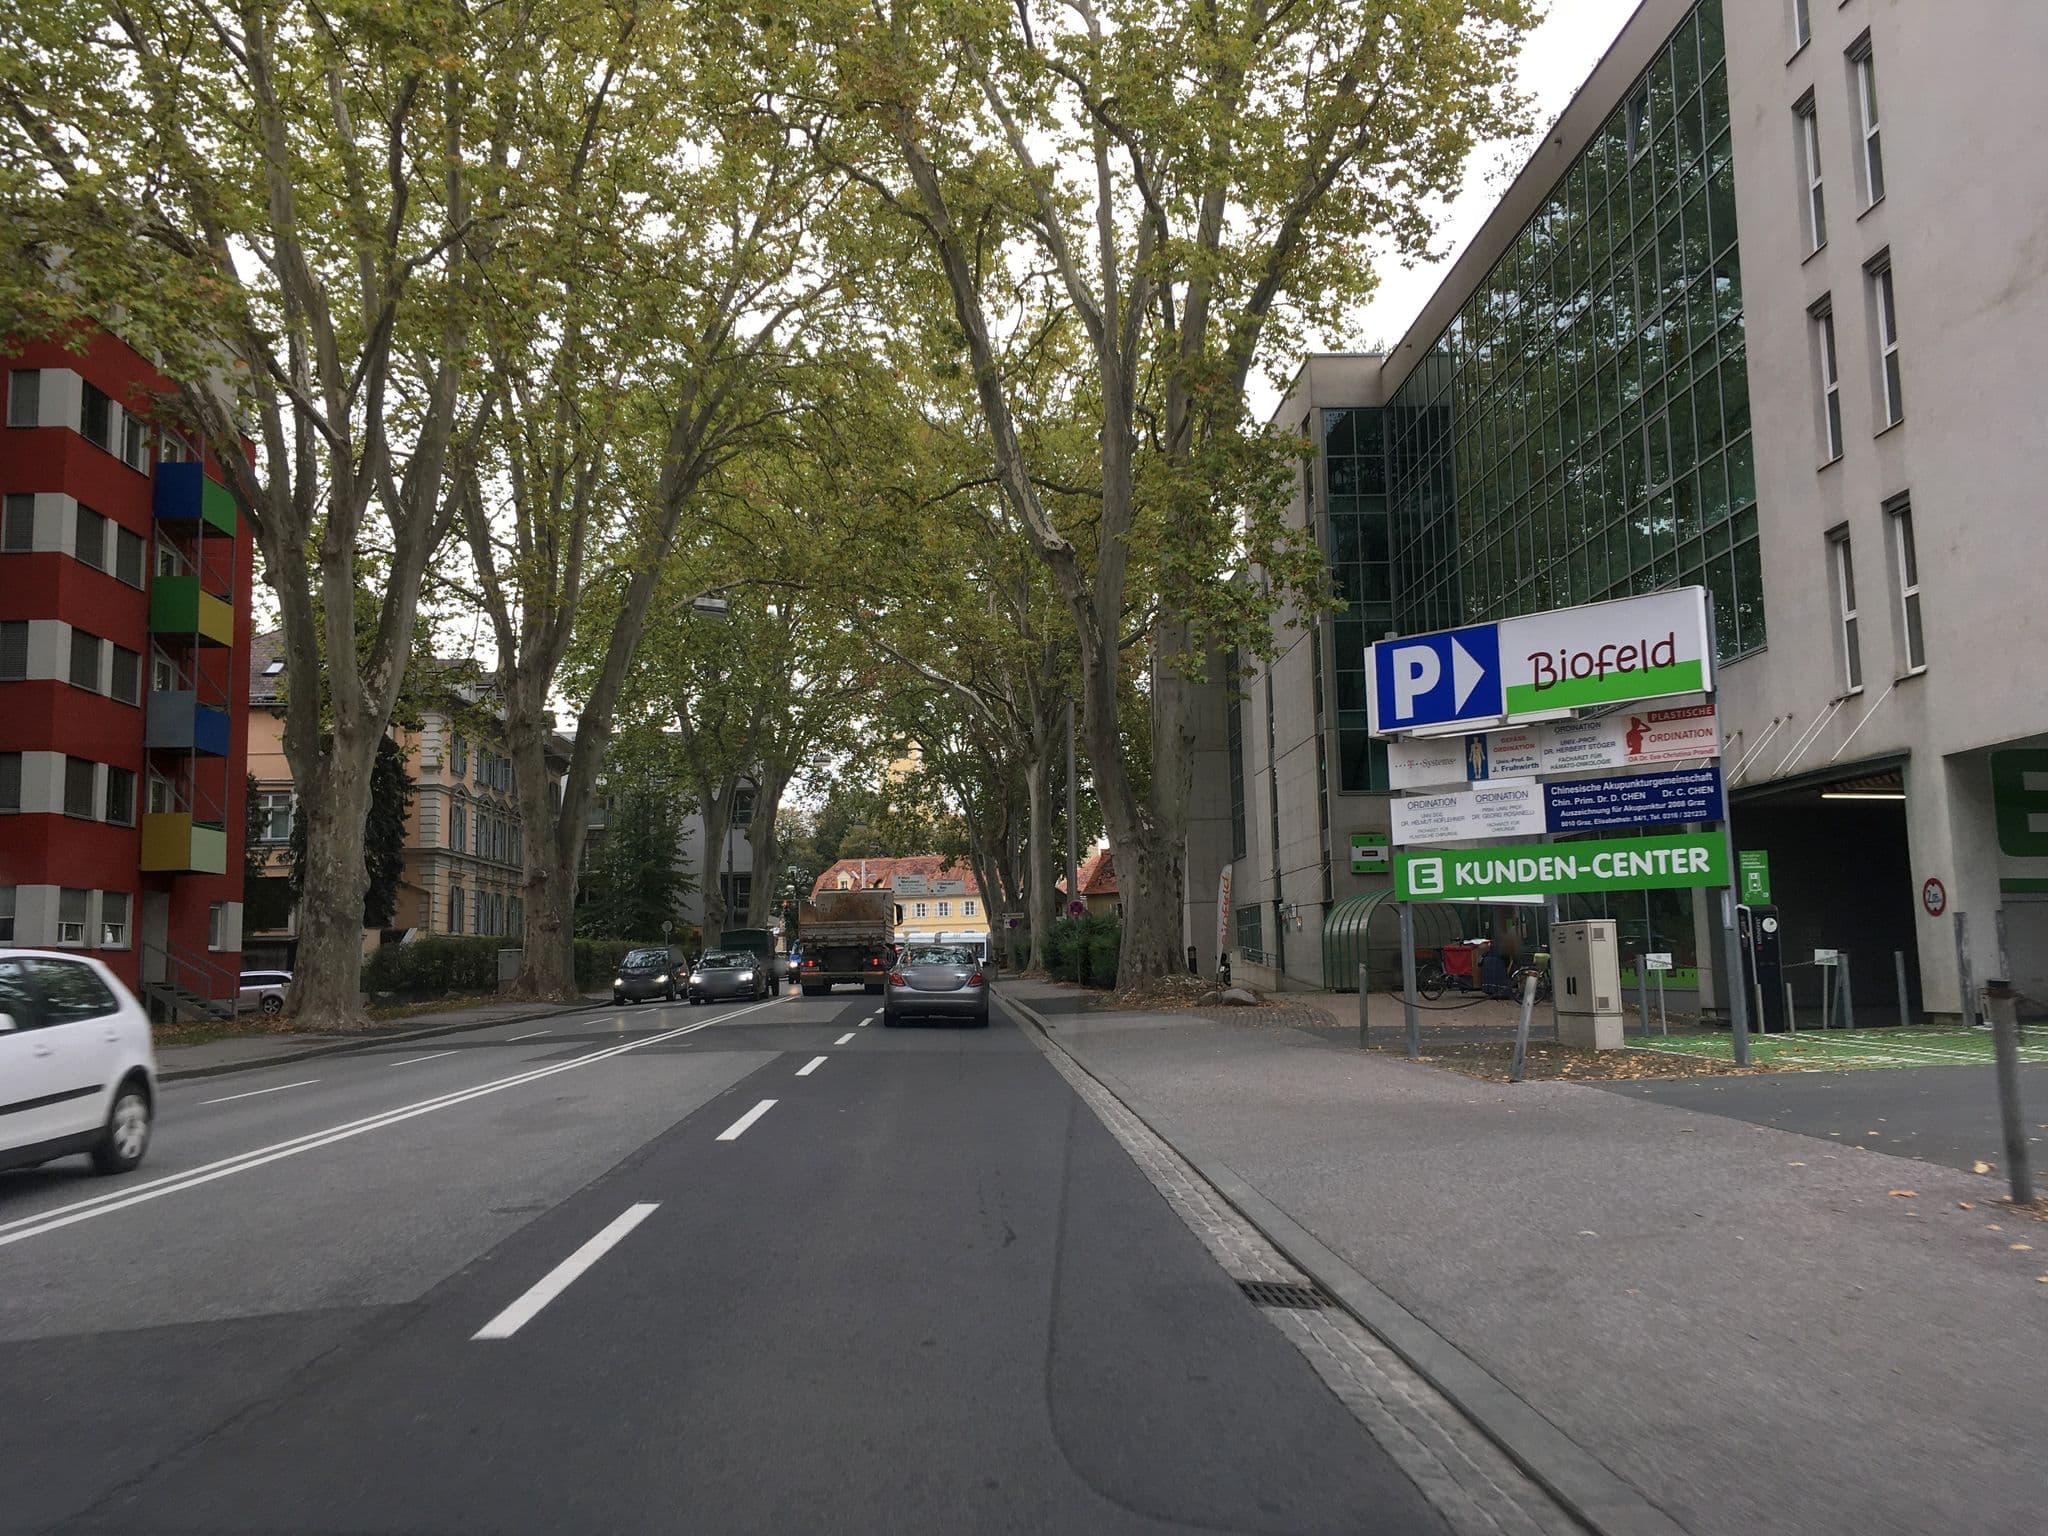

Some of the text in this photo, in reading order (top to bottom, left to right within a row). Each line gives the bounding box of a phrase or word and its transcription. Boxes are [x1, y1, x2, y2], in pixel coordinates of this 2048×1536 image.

[1527, 631, 1677, 692] Biofeld
[1392, 644, 1441, 720] P
[1651, 706, 1713, 720] PLASTISCHE
[1648, 728, 1714, 743] ORDINATION
[1588, 740, 1616, 751] STÖGER
[1551, 772, 1713, 796] Chinesische Akupunkturgemeinschaft
[1662, 785, 1715, 798] Dr. C. CHEN
[1407, 797, 1457, 810] ORDINATION
[1475, 790, 1529, 804] ORDINATION
[1551, 791, 1646, 807] Chin. Prim. Dr. D. CHEN
[1560, 806, 1611, 818] Auszeichnung
[1612, 805, 1623, 813] für
[1623, 802, 1667, 814] Akupunktur
[1687, 799, 1706, 807] Graz
[1455, 846, 1711, 887] KUNDEN-CENTER
